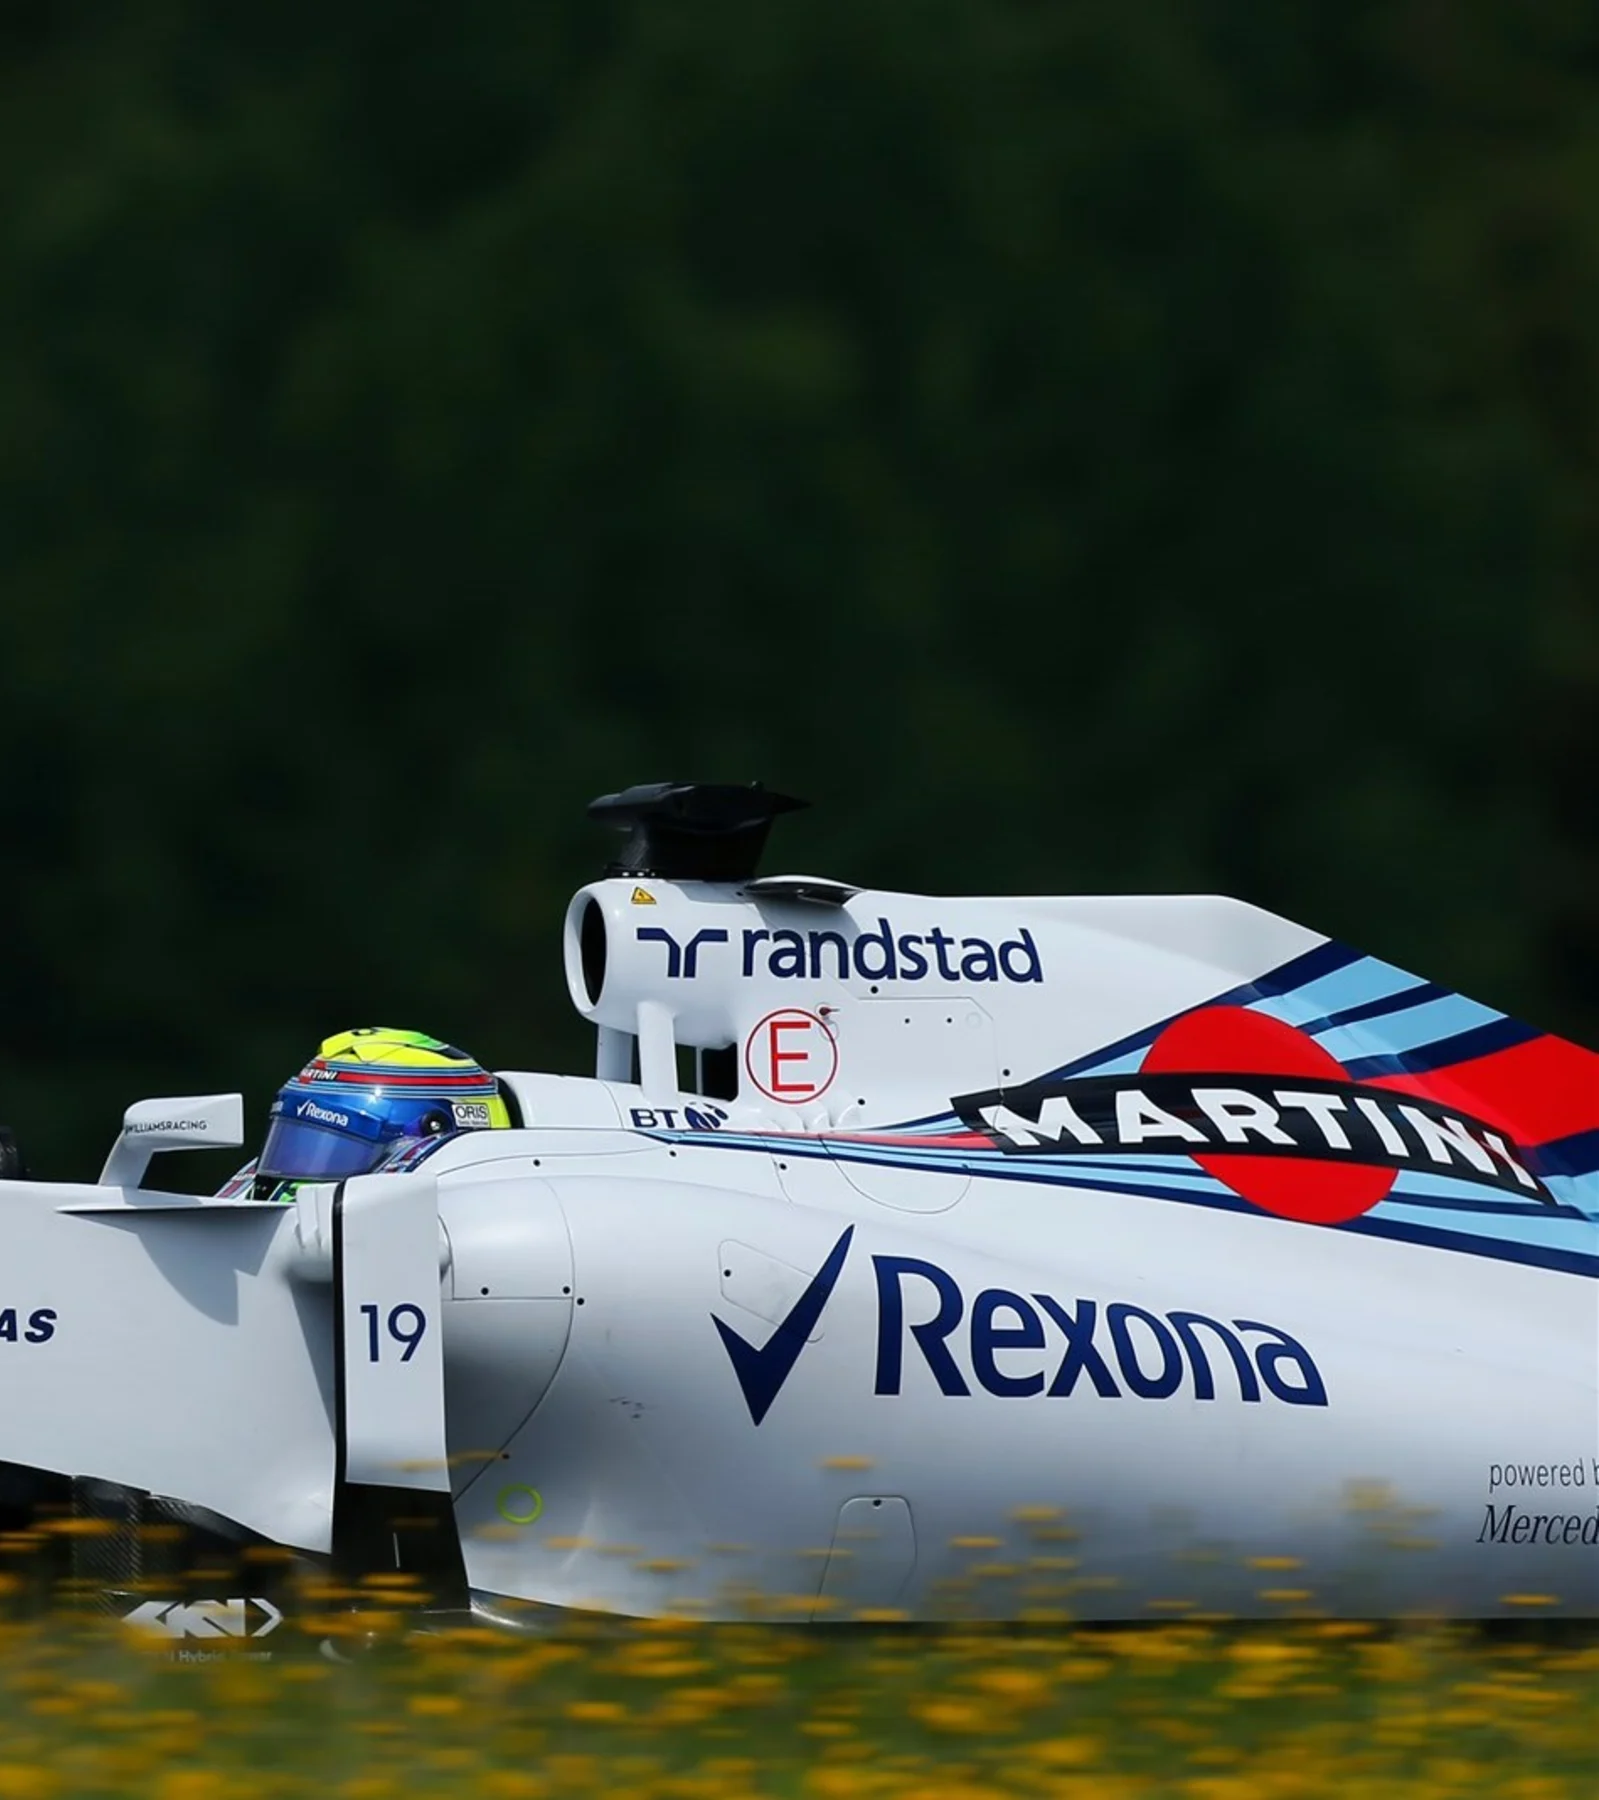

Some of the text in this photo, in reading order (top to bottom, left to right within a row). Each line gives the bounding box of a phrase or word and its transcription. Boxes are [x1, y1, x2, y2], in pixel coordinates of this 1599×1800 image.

[742, 917, 1043, 983] randstad
[769, 1019, 816, 1093] E
[306, 1102, 349, 1127] Rexona
[455, 1105, 488, 1119] ORIS
[629, 1108, 679, 1129] BT
[978, 1088, 1539, 1191] MARTINI
[360, 1303, 426, 1363] 19
[871, 1254, 1329, 1407] Rexona
[1489, 1457, 1585, 1494] powered
